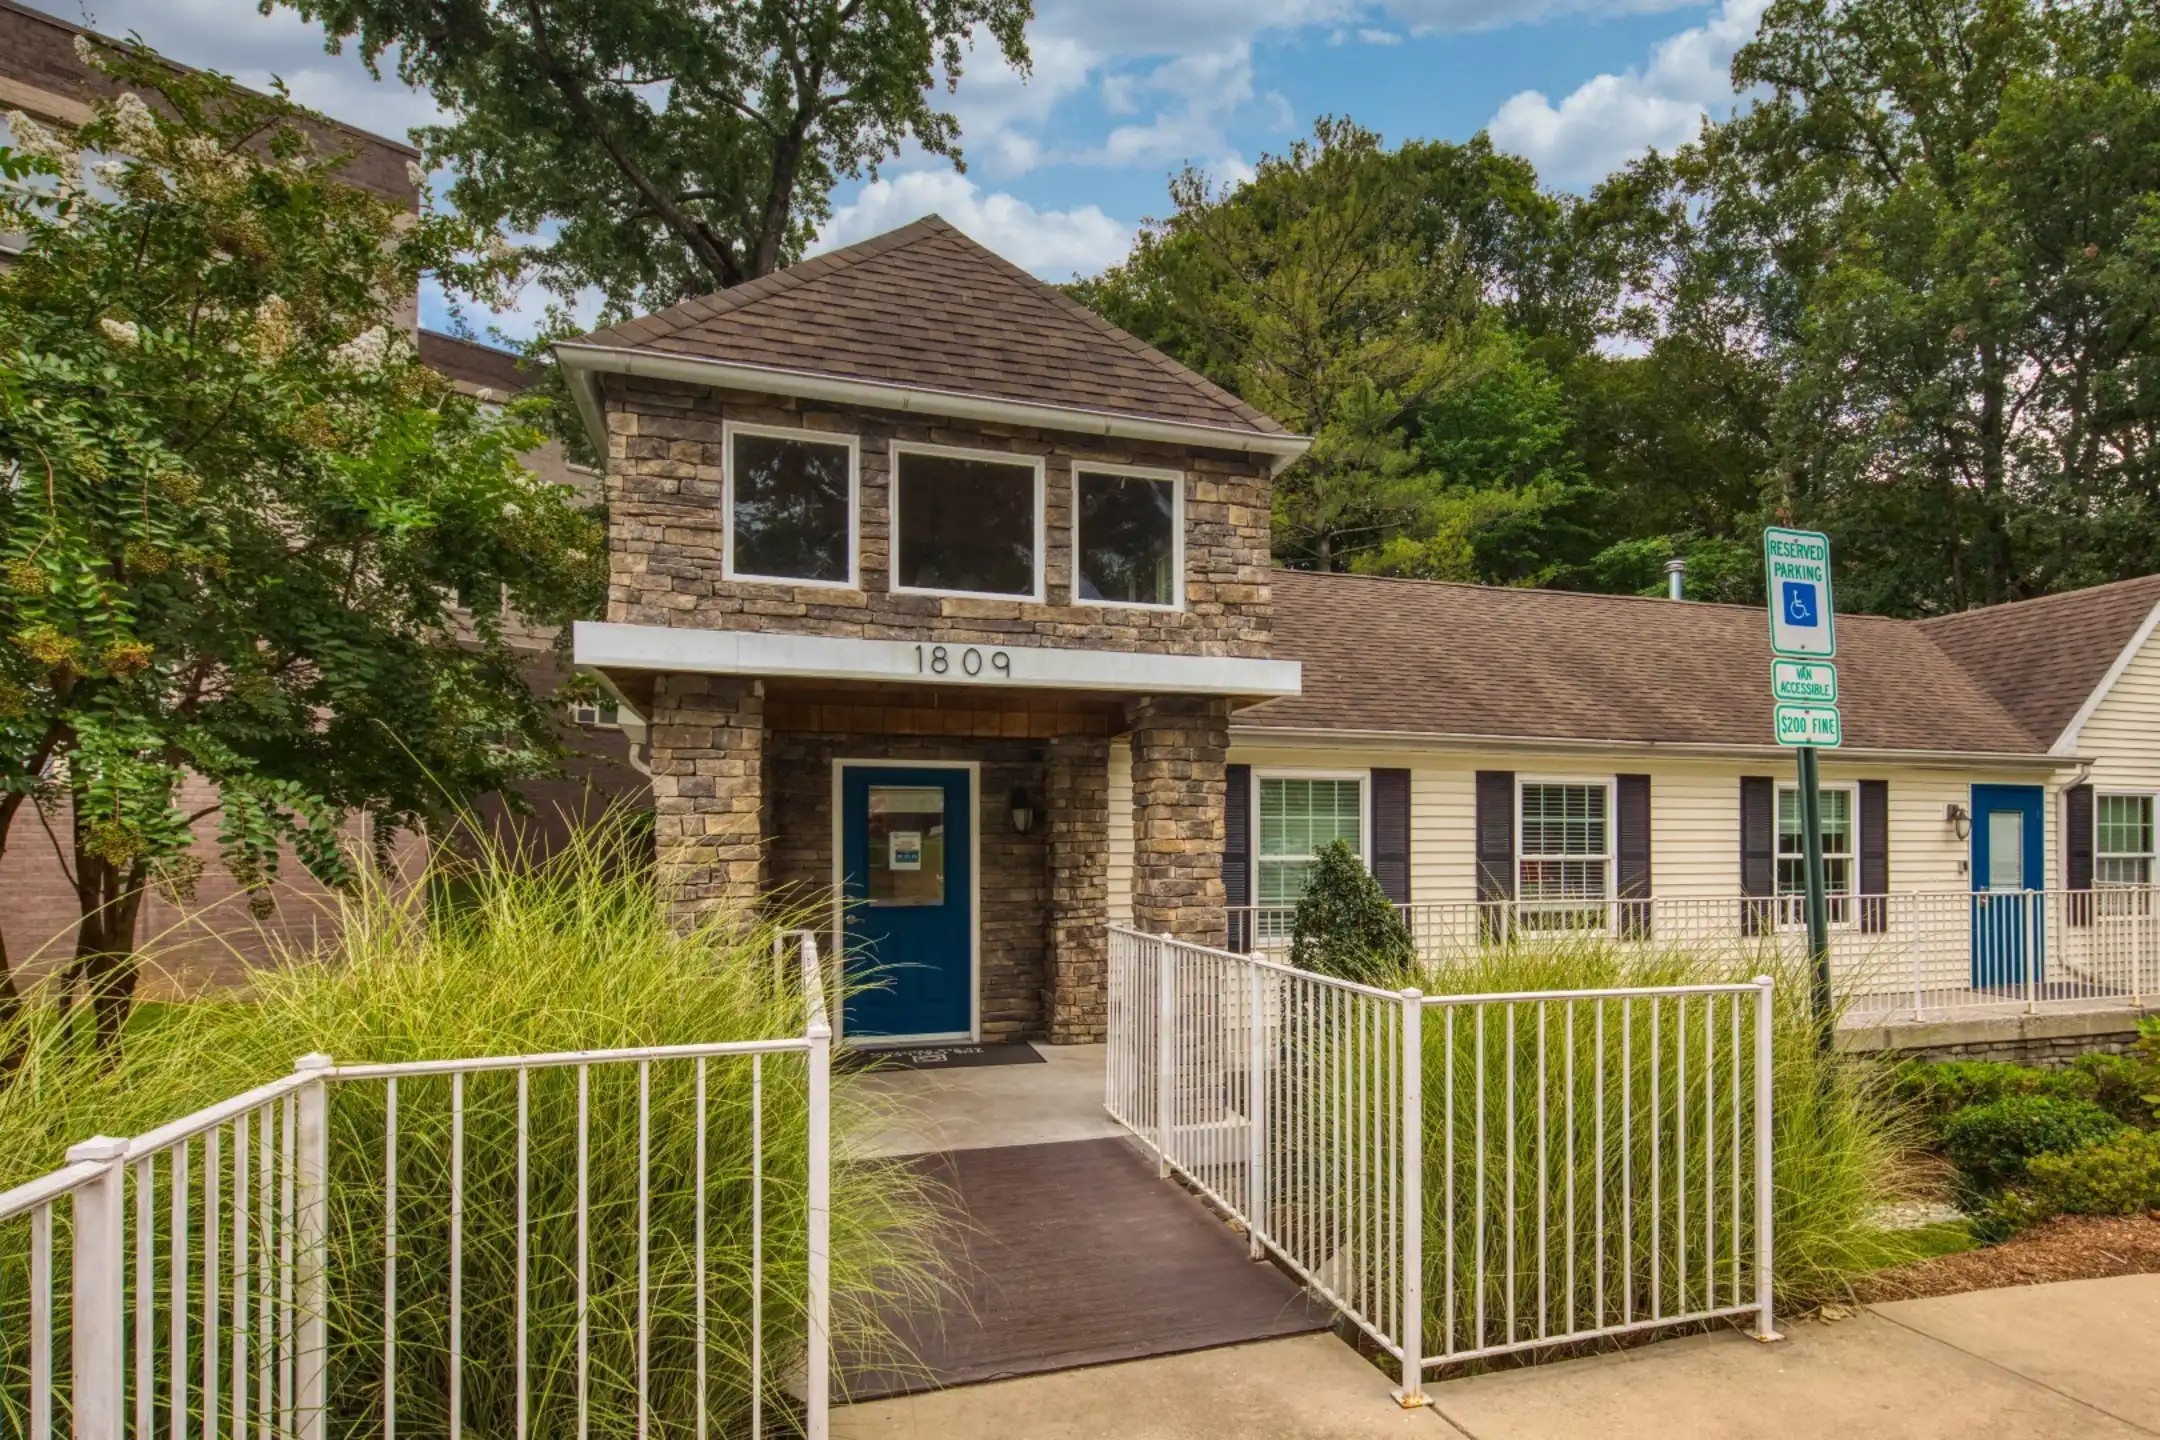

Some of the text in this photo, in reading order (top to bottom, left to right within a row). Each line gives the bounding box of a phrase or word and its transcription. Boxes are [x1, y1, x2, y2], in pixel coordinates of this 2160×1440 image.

[1769, 539, 1824, 561] RESERVED
[1774, 562, 1822, 581] PARKING
[915, 644, 1010, 678] 1809
[1796, 667, 1812, 680] VAN
[1780, 681, 1830, 696] ACCESSIBLE
[1781, 716, 1835, 734] $200 FINE
